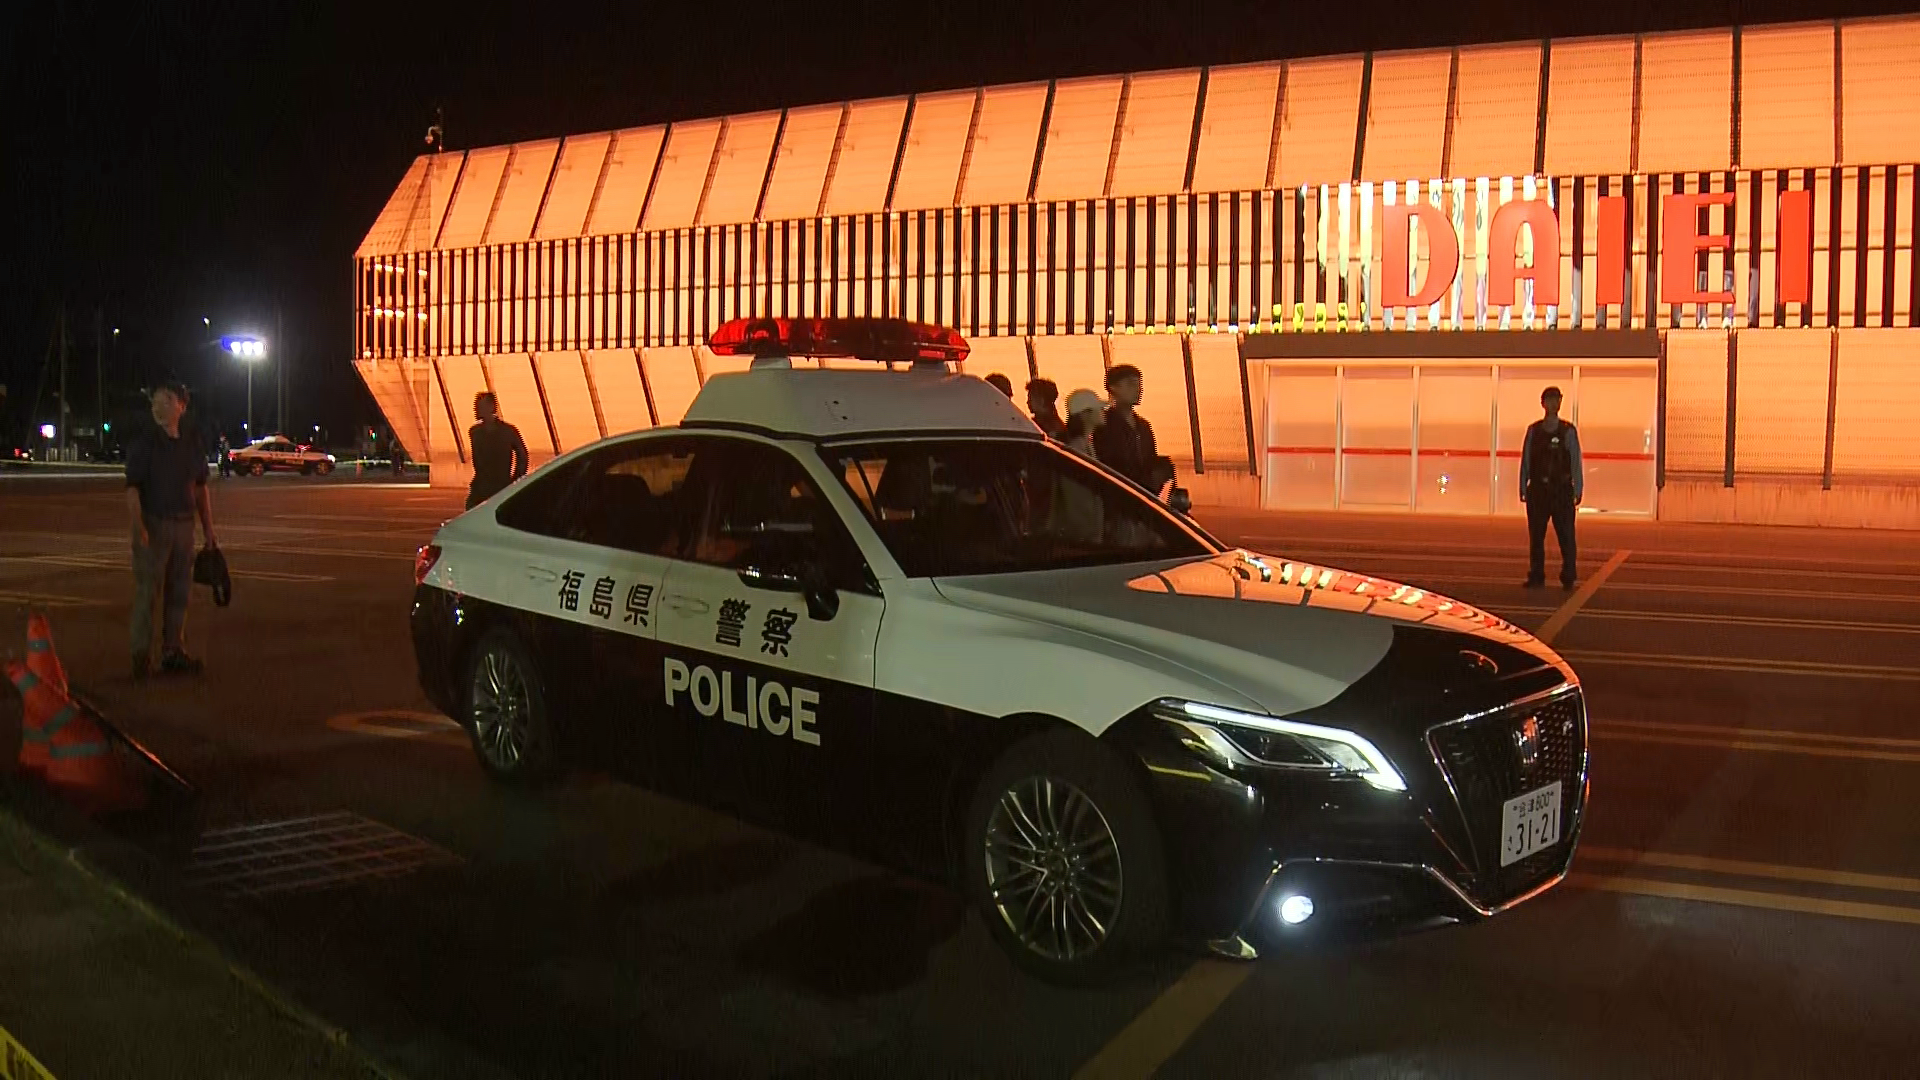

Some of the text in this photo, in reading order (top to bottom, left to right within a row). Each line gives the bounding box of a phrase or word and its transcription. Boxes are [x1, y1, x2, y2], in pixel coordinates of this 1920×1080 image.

[1380, 190, 1810, 307] DAIEI
[558, 569, 798, 658] 福島県 警察
[664, 656, 821, 747] POLICE
